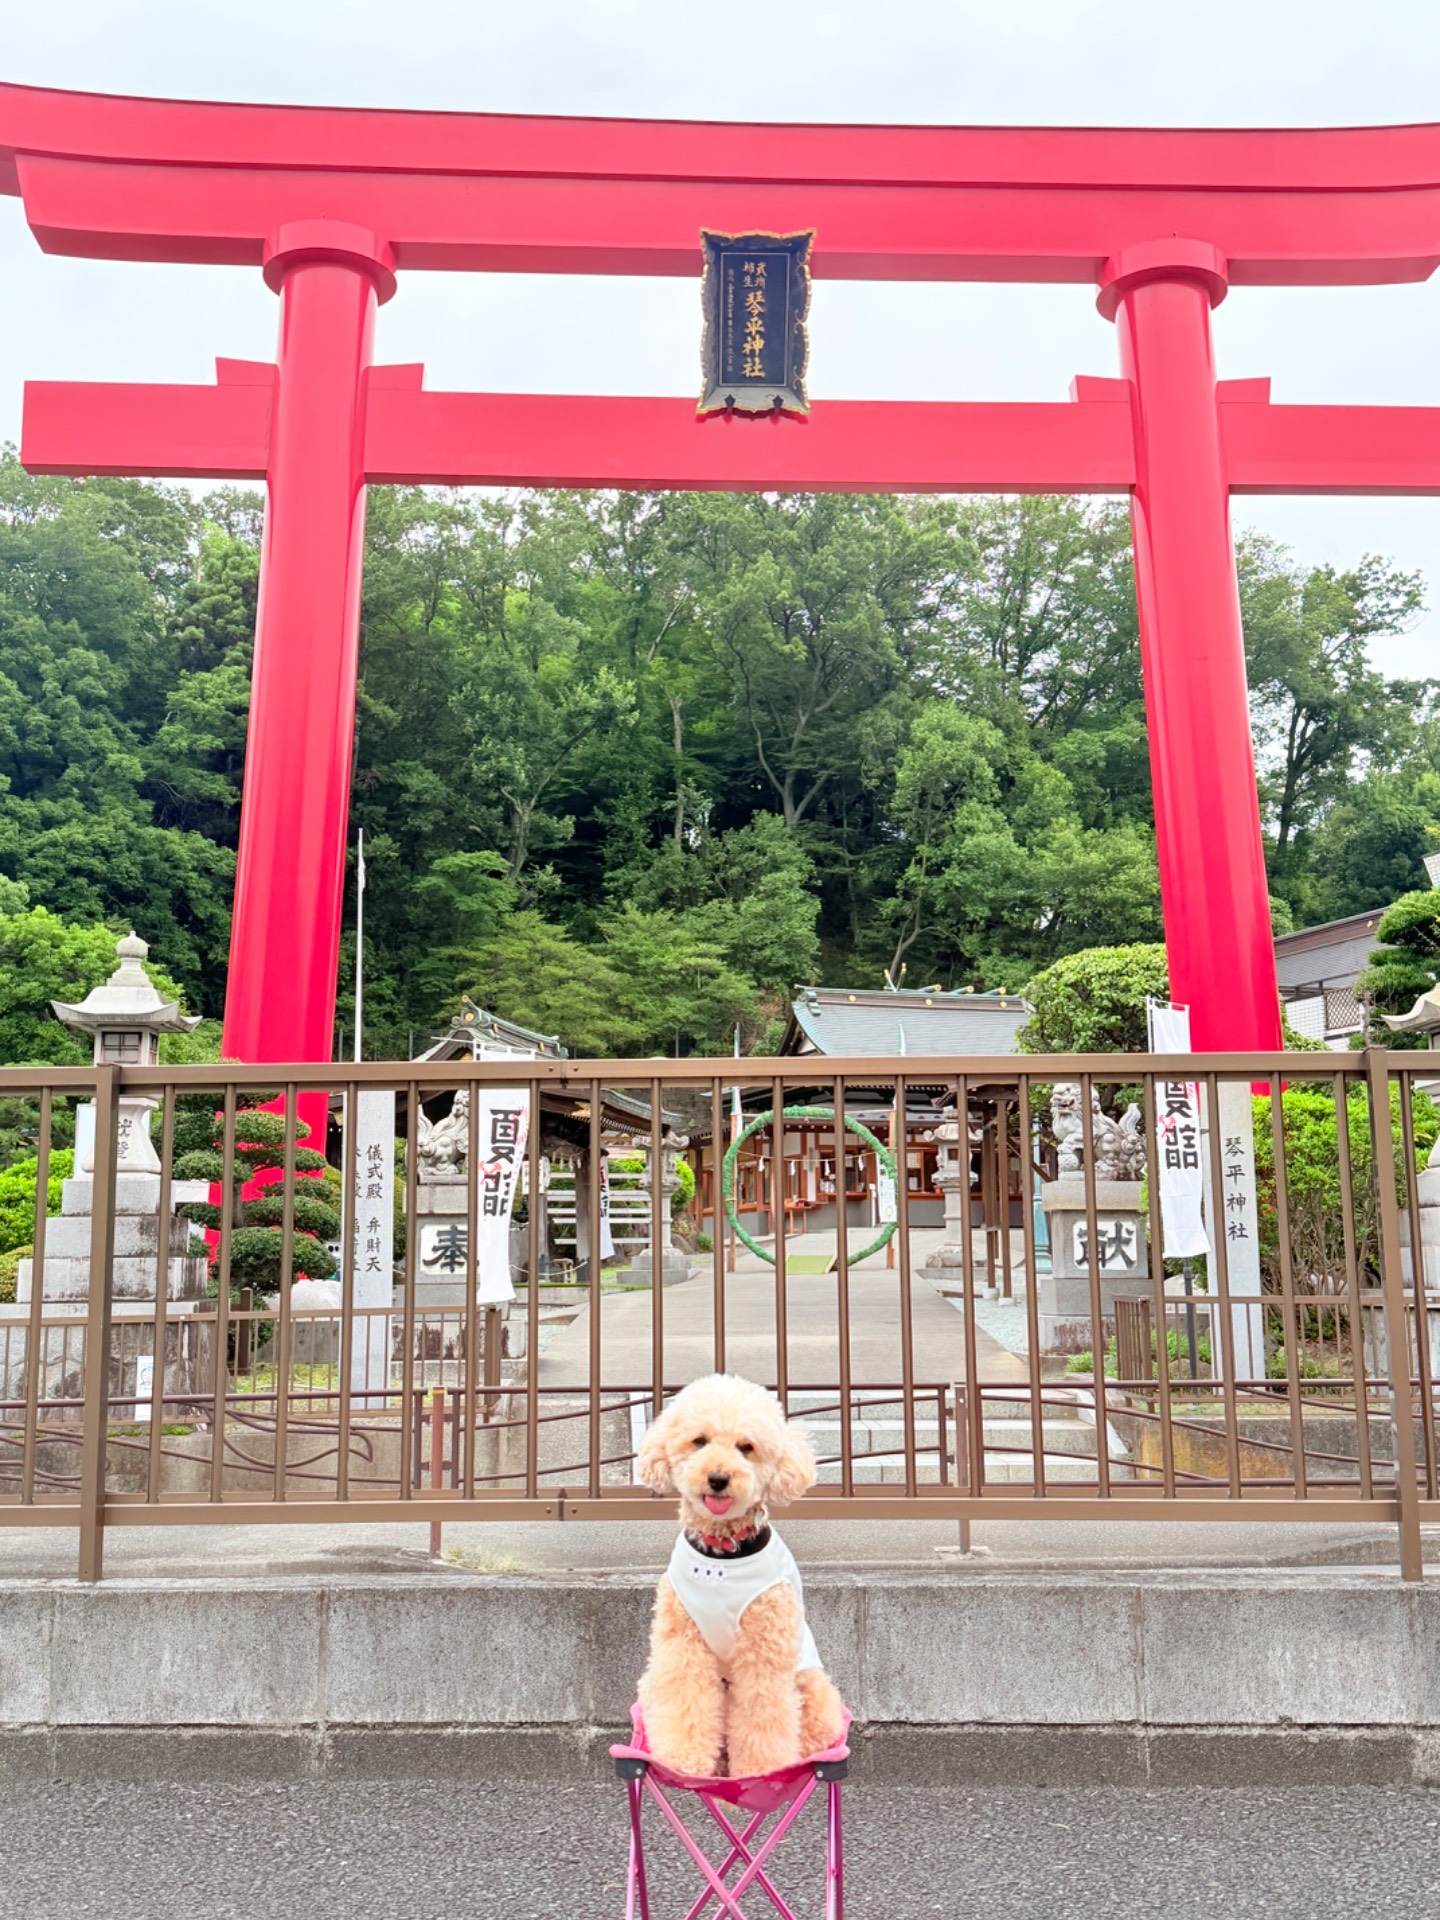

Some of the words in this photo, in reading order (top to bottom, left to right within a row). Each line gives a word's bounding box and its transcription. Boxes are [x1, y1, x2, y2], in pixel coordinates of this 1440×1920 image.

[741, 291, 766, 378] 琴平神社
[366, 1144, 383, 1199] 儀式殿
[1225, 1136, 1248, 1240] 琴平神社
[366, 1217, 382, 1272] 弁財天
[422, 1224, 480, 1273] 奉
[1075, 1221, 1136, 1269] 献
